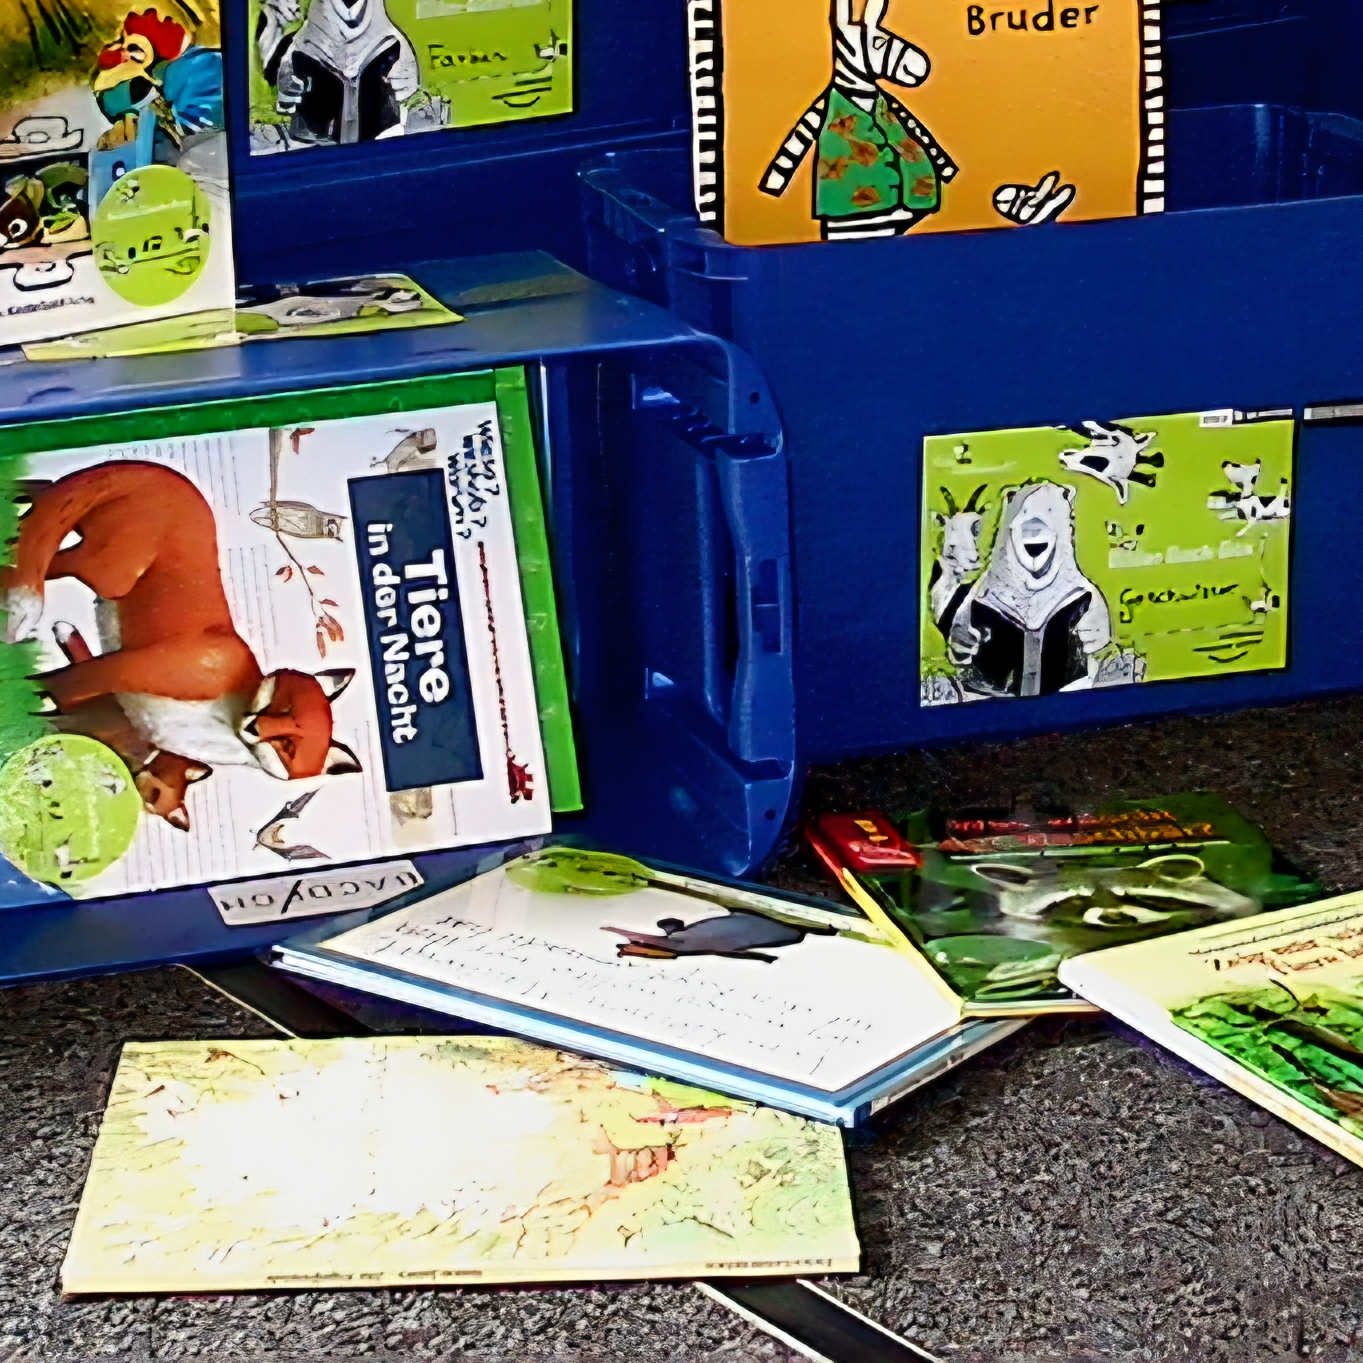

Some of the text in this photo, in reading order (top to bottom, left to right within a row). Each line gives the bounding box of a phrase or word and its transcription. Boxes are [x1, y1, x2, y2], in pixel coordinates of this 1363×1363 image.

[367, 522, 420, 746] in der Nacht
[403, 547, 451, 705] Tiere
